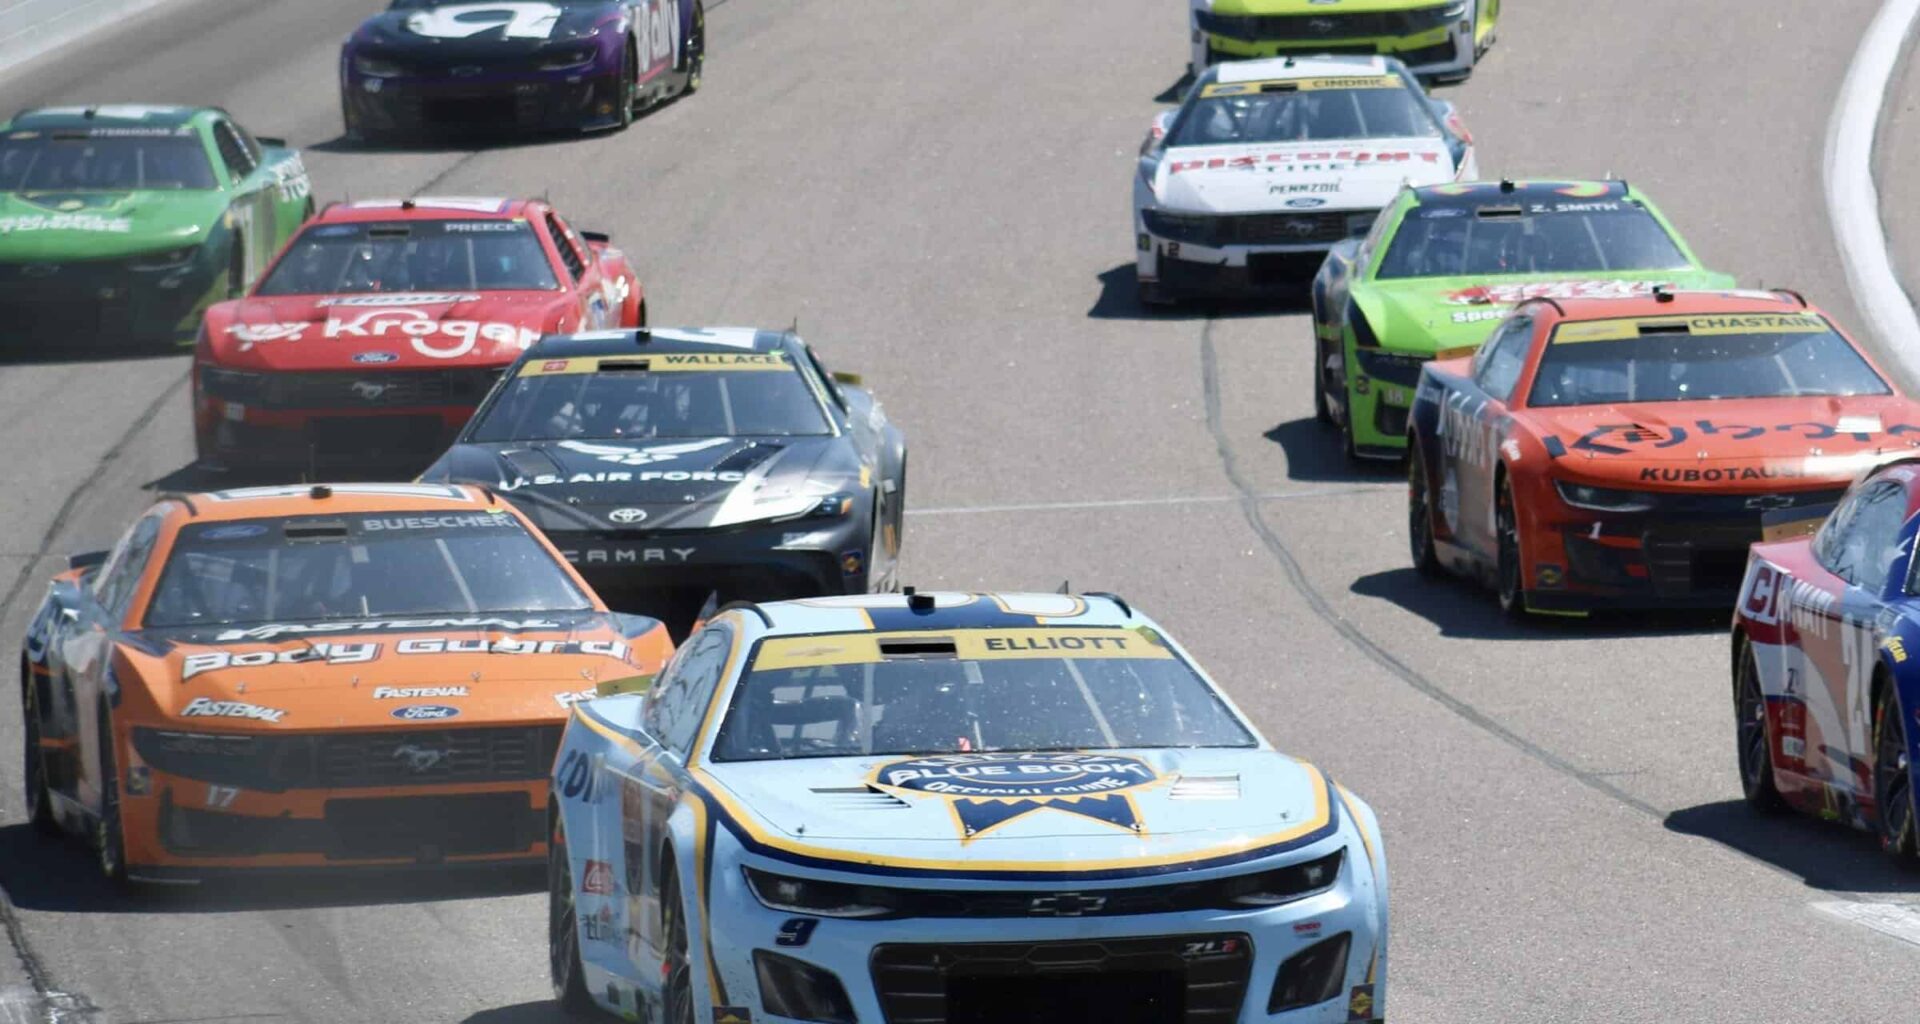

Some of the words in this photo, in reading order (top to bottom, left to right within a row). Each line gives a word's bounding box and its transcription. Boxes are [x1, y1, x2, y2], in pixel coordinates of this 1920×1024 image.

[1312, 77, 1386, 89] CINDRIC
[1557, 202, 1619, 213] SMITH
[445, 224, 519, 233] PREECE
[1690, 315, 1824, 329] CHASTAIN
[664, 352, 786, 366] WALLACE
[569, 472, 634, 483] AIR
[1589, 521, 1600, 539] 1
[985, 635, 1128, 652] ELLIOTT
[373, 686, 470, 700] FASTENAL
[181, 698, 288, 722] FASTENAL
[403, 706, 450, 720] Ford
[890, 764, 1012, 786] BLUE
[1018, 763, 1150, 784] BOOK
[206, 785, 241, 807] 17
[777, 918, 820, 946] 9
